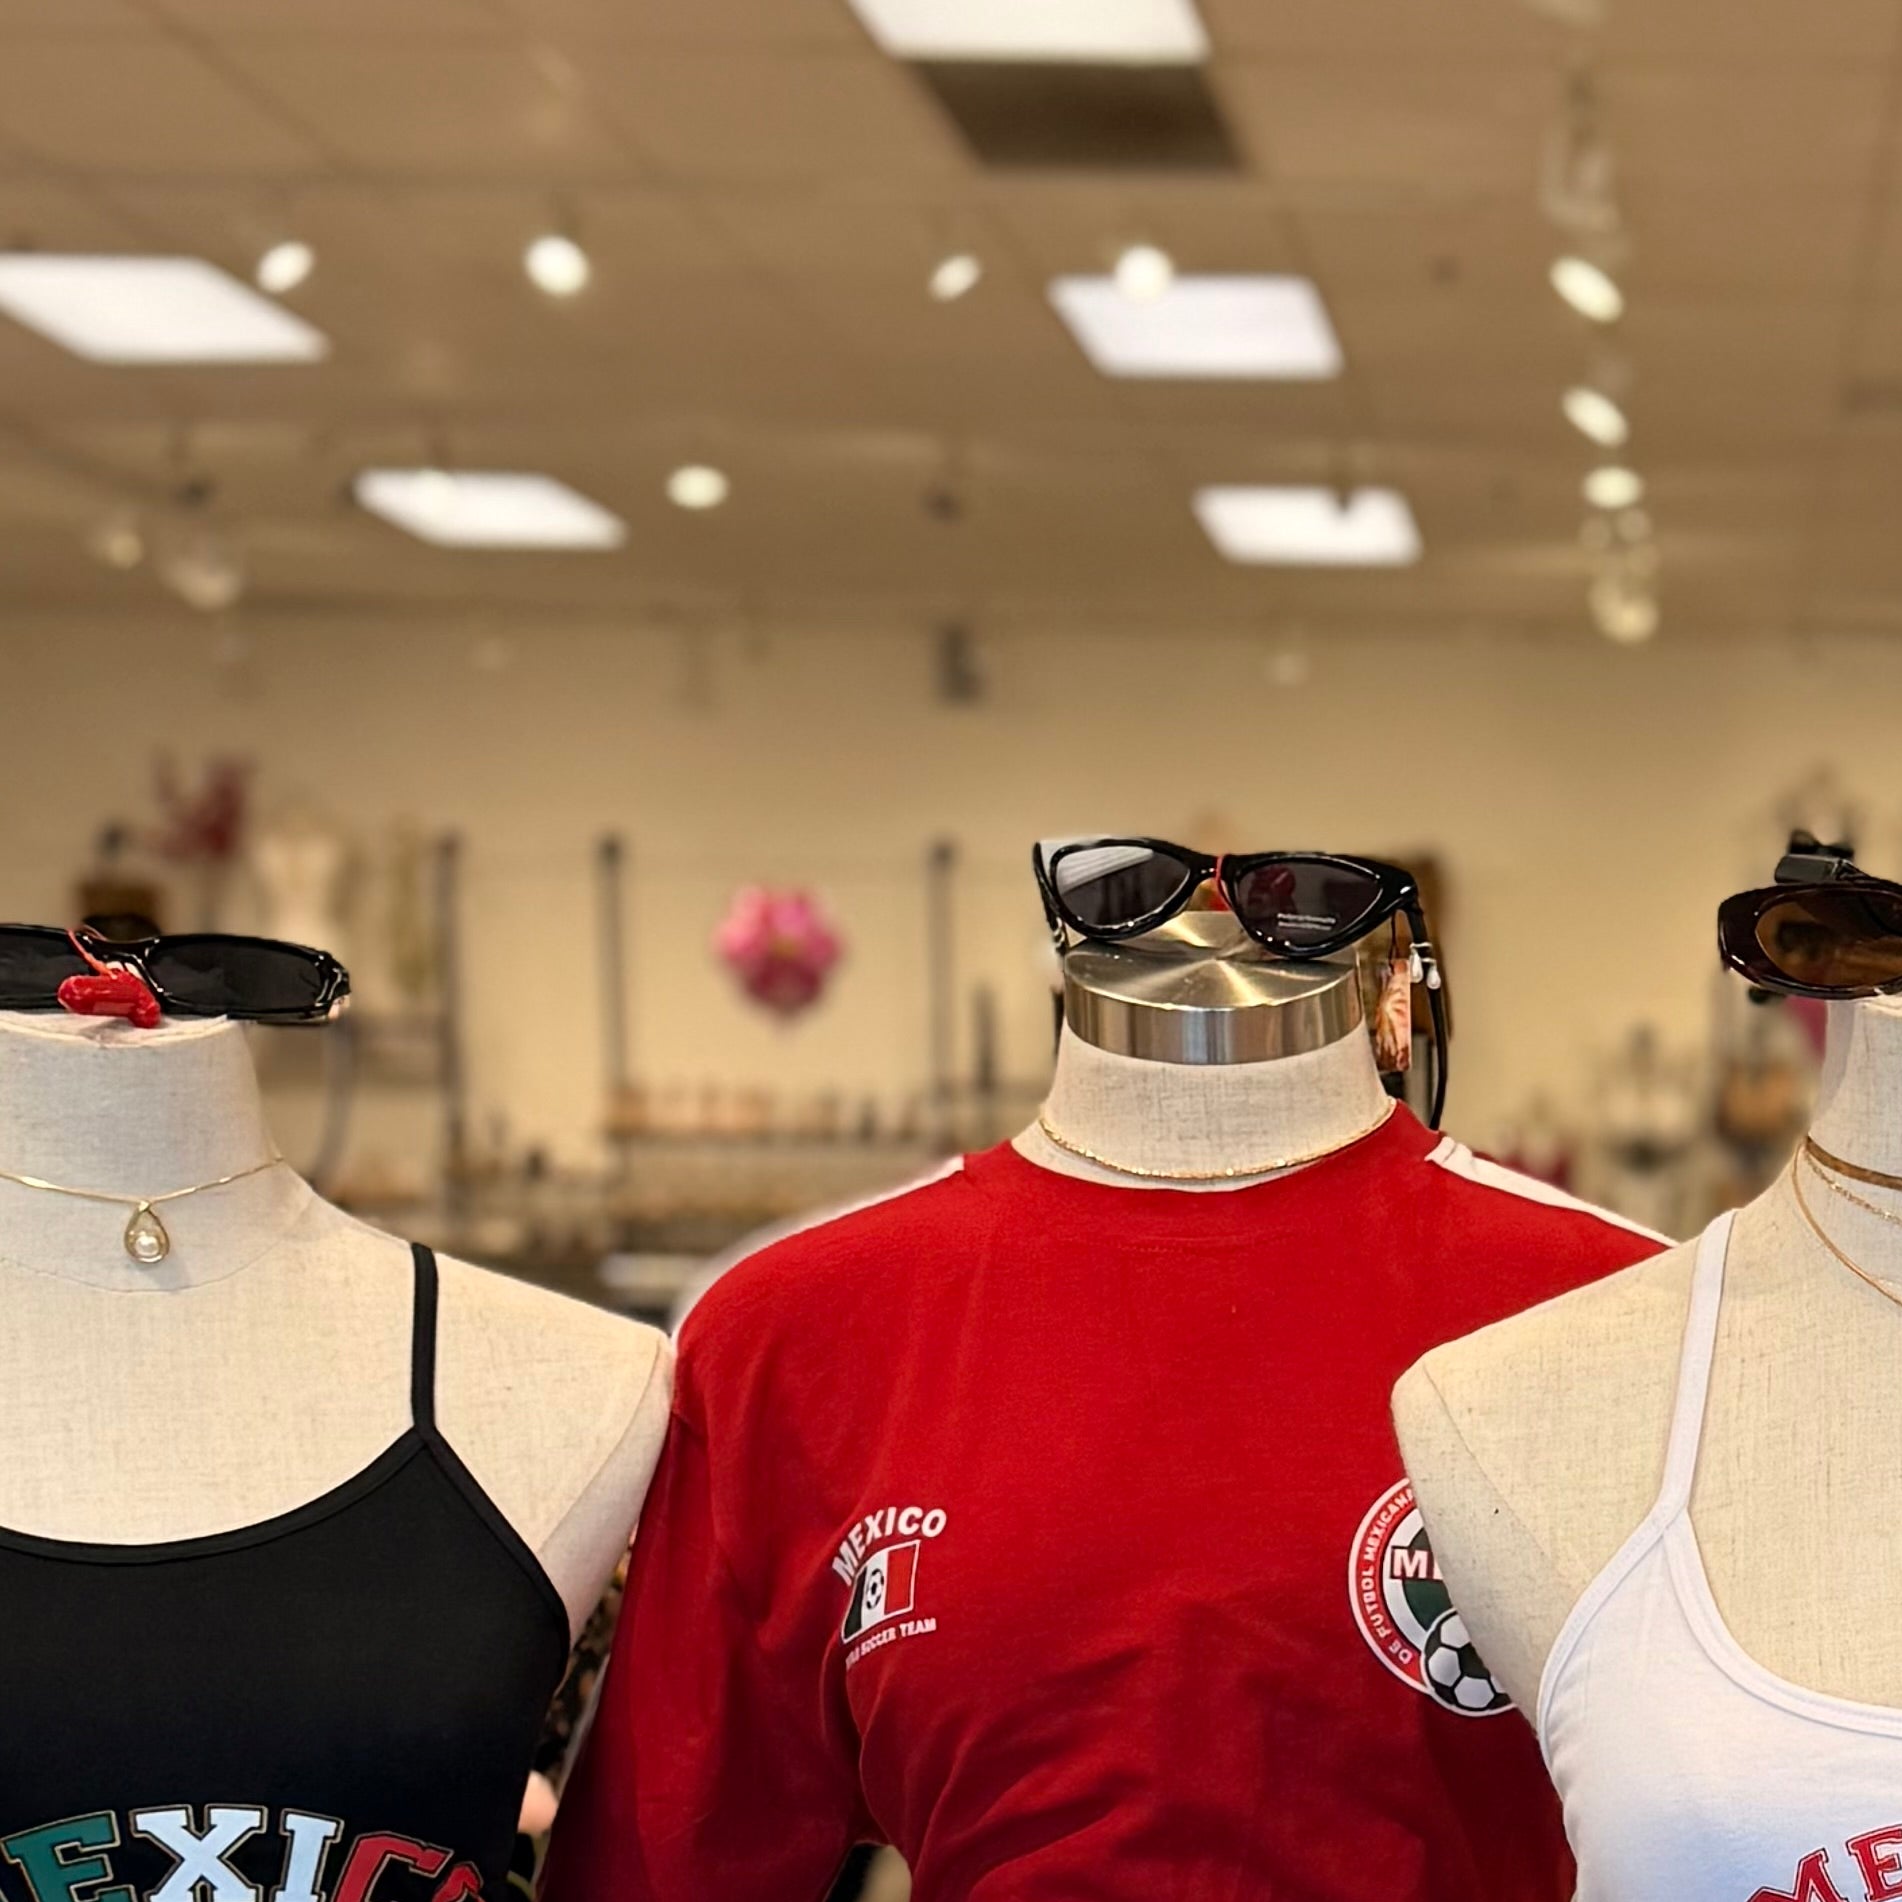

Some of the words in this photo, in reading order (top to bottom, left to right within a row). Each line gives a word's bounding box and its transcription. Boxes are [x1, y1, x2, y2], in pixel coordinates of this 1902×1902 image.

[832, 1506, 947, 1586] MEXICO
[899, 1617, 937, 1638] TEAM
[1361, 1565, 1392, 1638] FUTBOL
